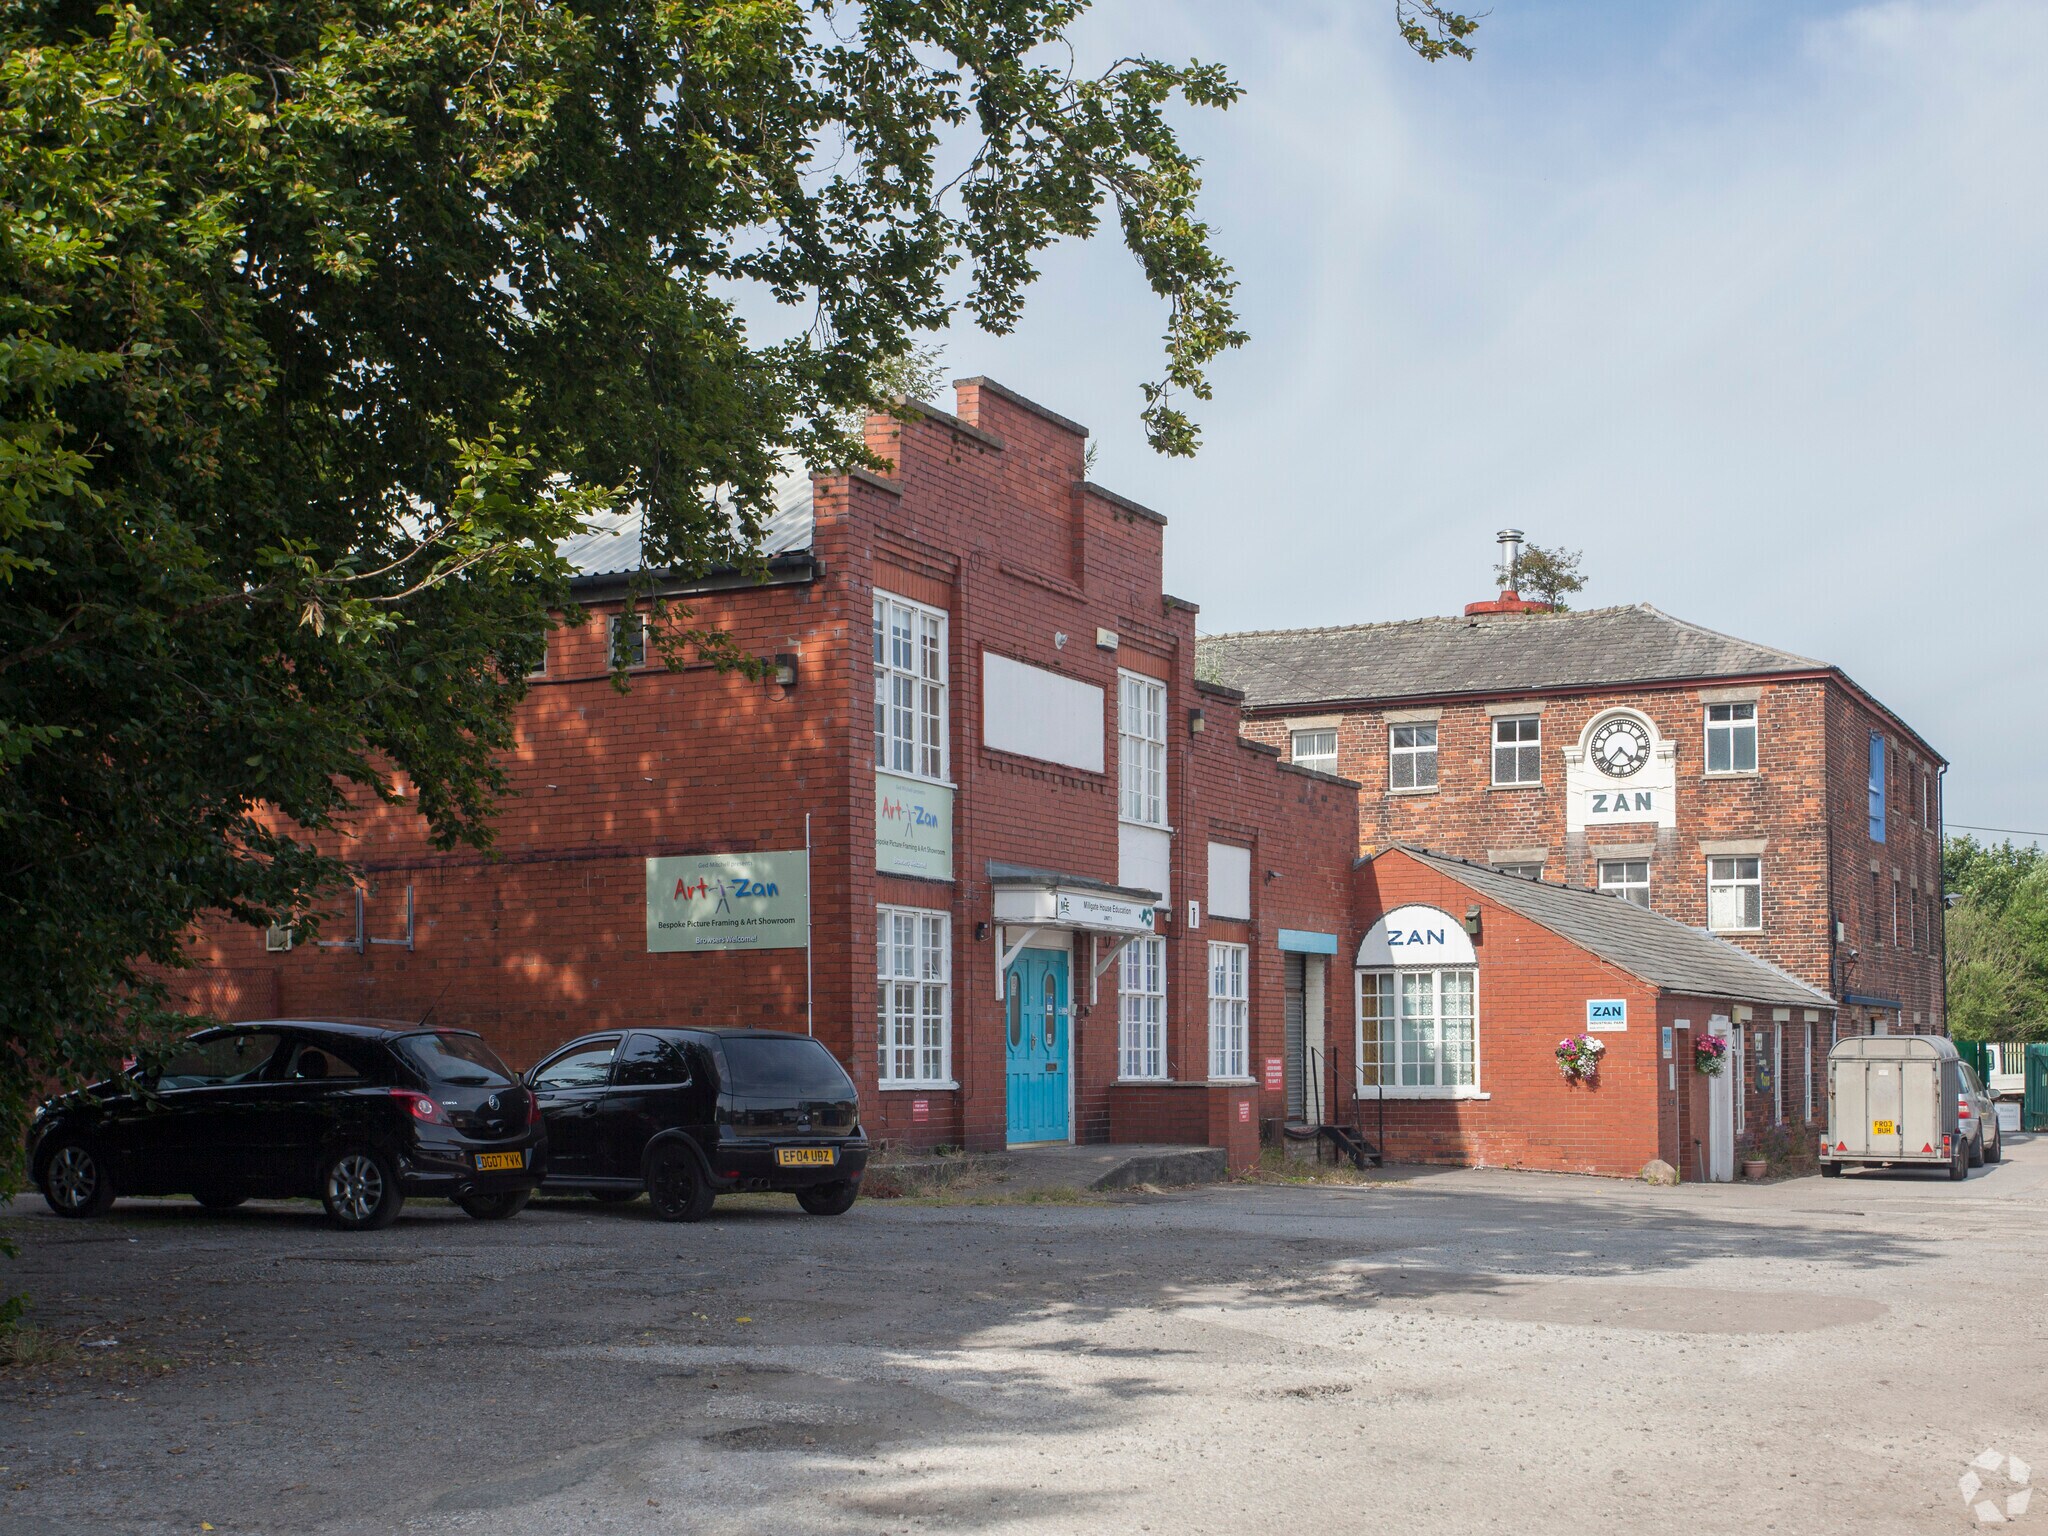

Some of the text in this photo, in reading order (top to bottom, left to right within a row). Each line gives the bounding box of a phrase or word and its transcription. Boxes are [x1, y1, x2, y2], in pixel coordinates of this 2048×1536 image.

[1592, 792, 1651, 813] ZAN
[889, 840, 902, 848] Picture
[902, 842, 917, 852] Framing
[927, 846, 946, 856] Showroom
[1083, 901, 1132, 915] Millgate House Education
[658, 921, 686, 930] Bespoke
[711, 919, 739, 927] Framing
[758, 917, 796, 925] Showroom
[695, 934, 758, 945] Browsers Welcome!
[1387, 929, 1444, 945] ZAN
[1592, 1007, 1621, 1016] ZAN
[481, 1156, 502, 1168] DG07
[783, 1151, 809, 1162] EF04
